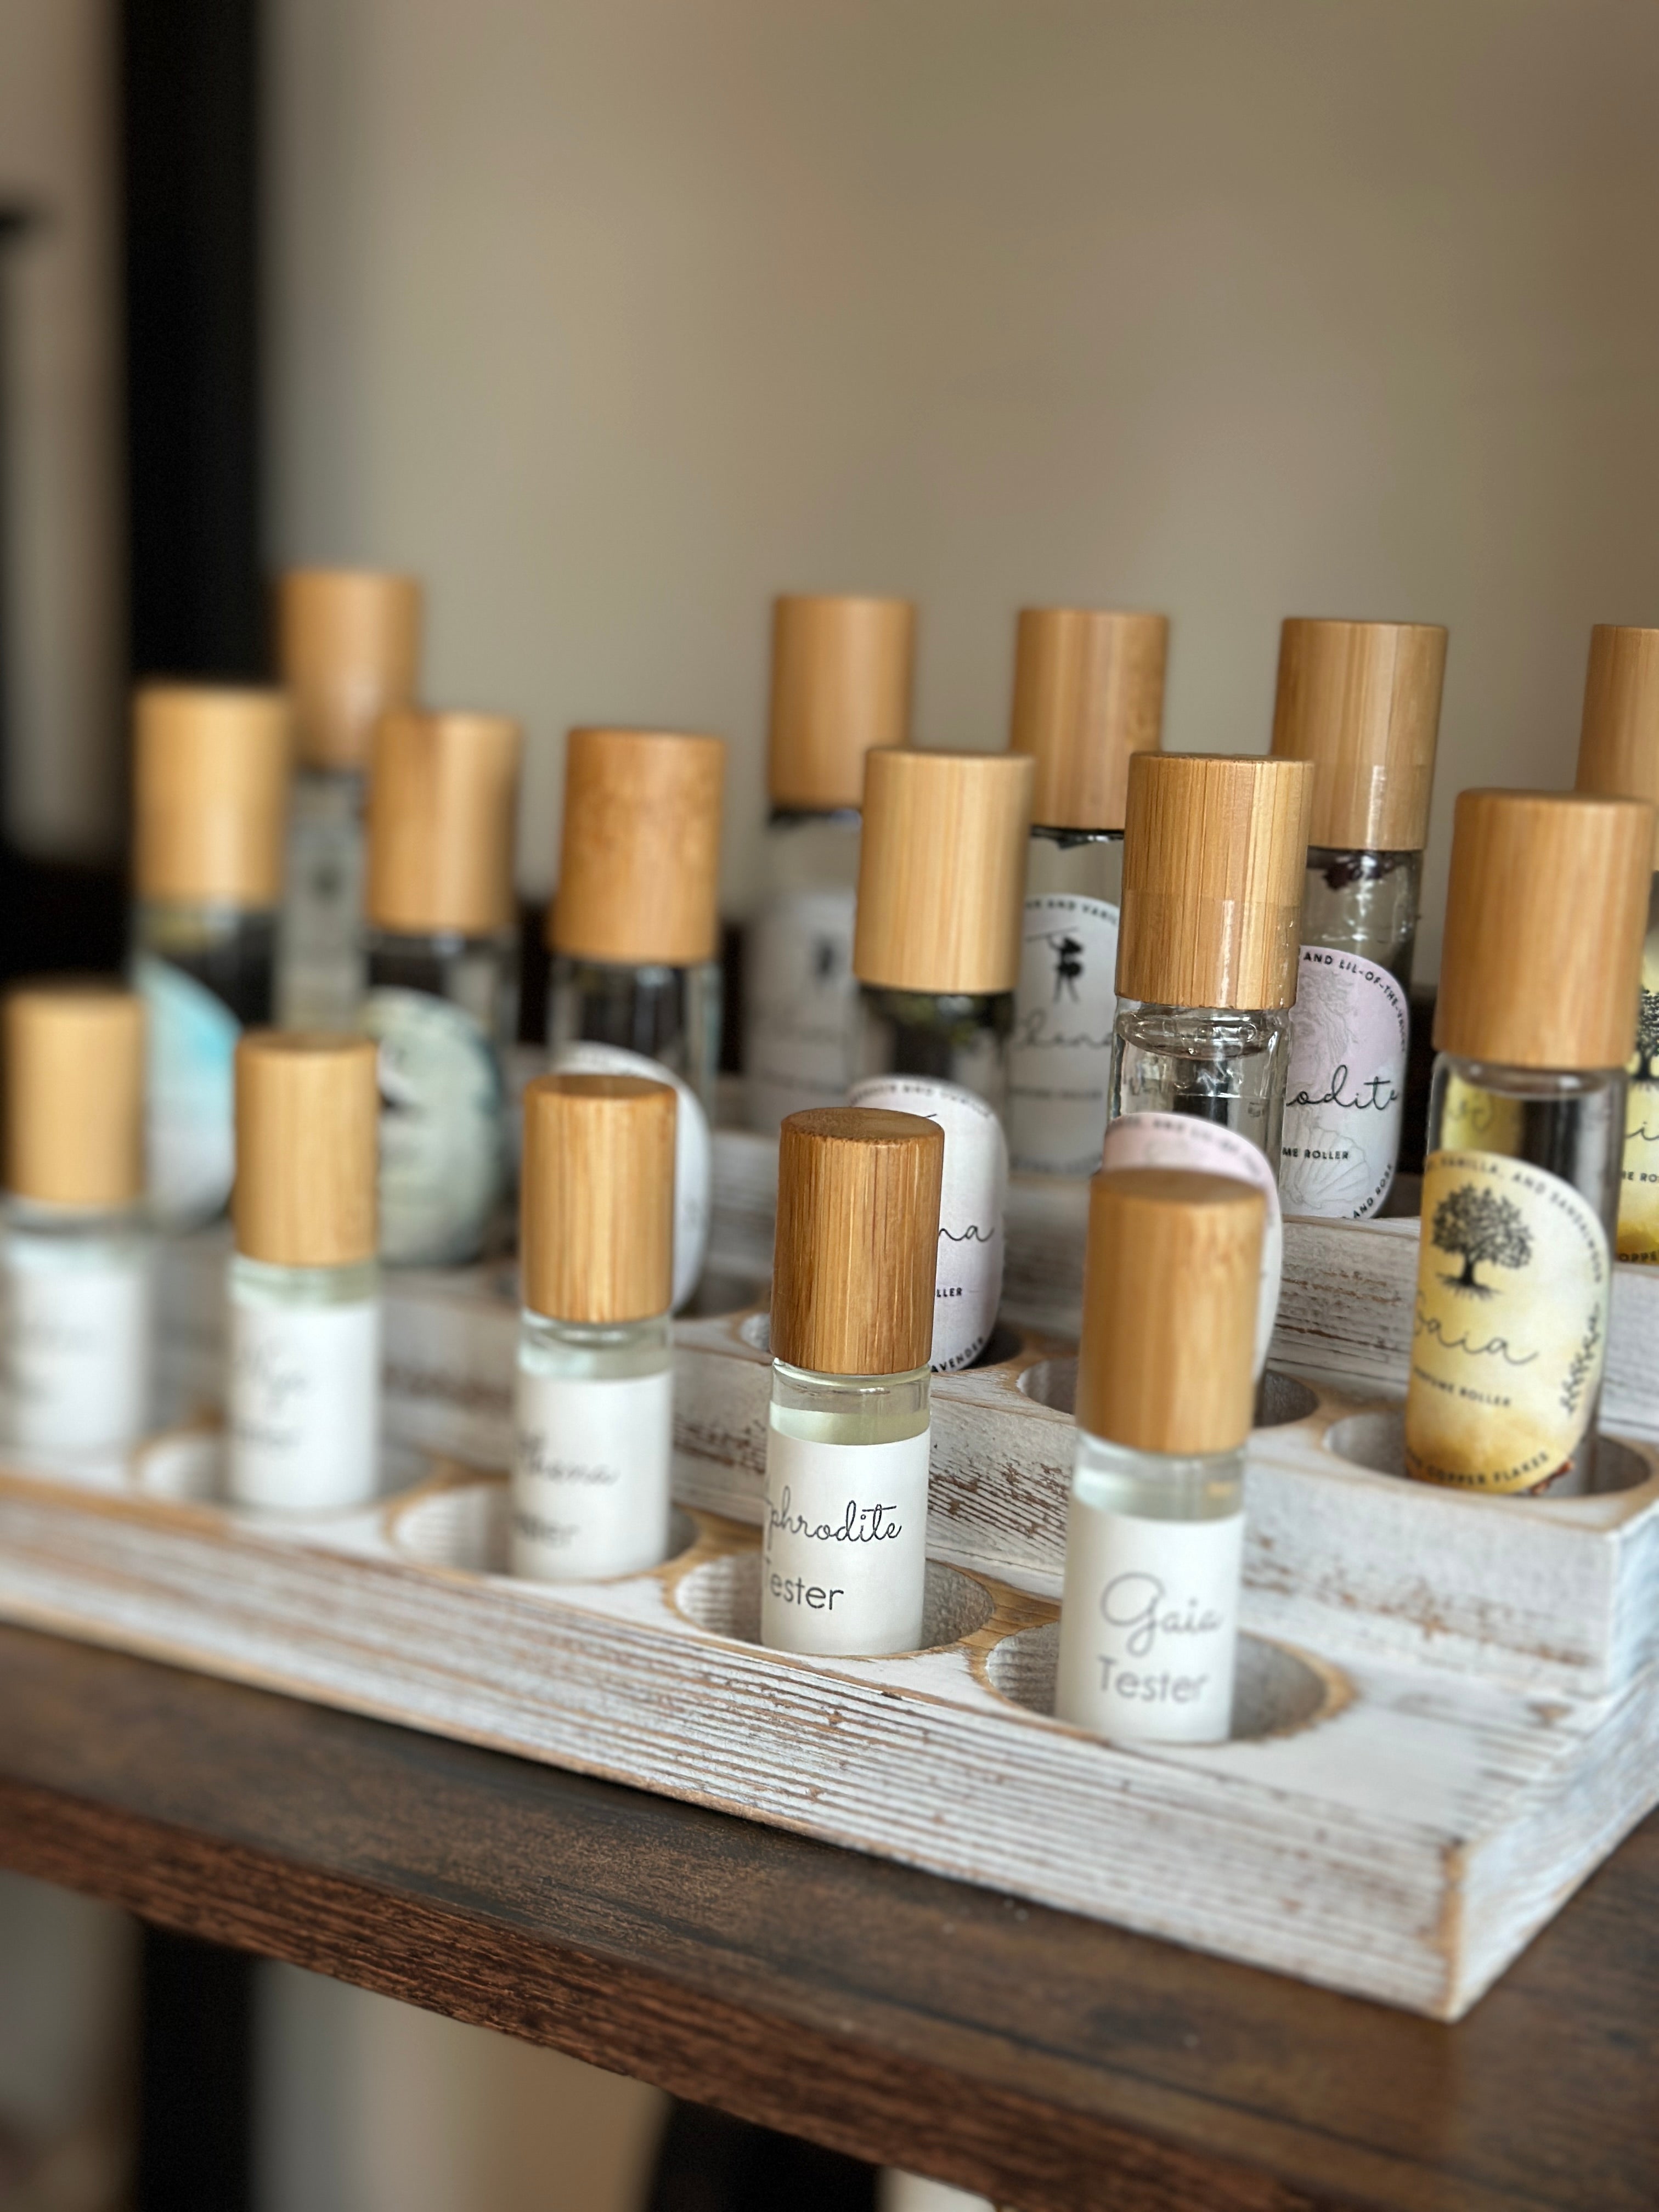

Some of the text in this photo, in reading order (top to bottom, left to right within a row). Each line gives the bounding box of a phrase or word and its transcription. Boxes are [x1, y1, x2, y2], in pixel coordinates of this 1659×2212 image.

[1304, 952, 1333, 964] AND
[1304, 1150, 1348, 1160] ROLLER
[1353, 1198, 1373, 1217] AND
[1460, 1387, 1511, 1406] ROLLER
[1493, 1452, 1549, 1482] FLAKES
[766, 1486, 902, 1550] phrodite
[766, 1564, 844, 1610] ester
[1097, 1655, 1210, 1703] Tester
